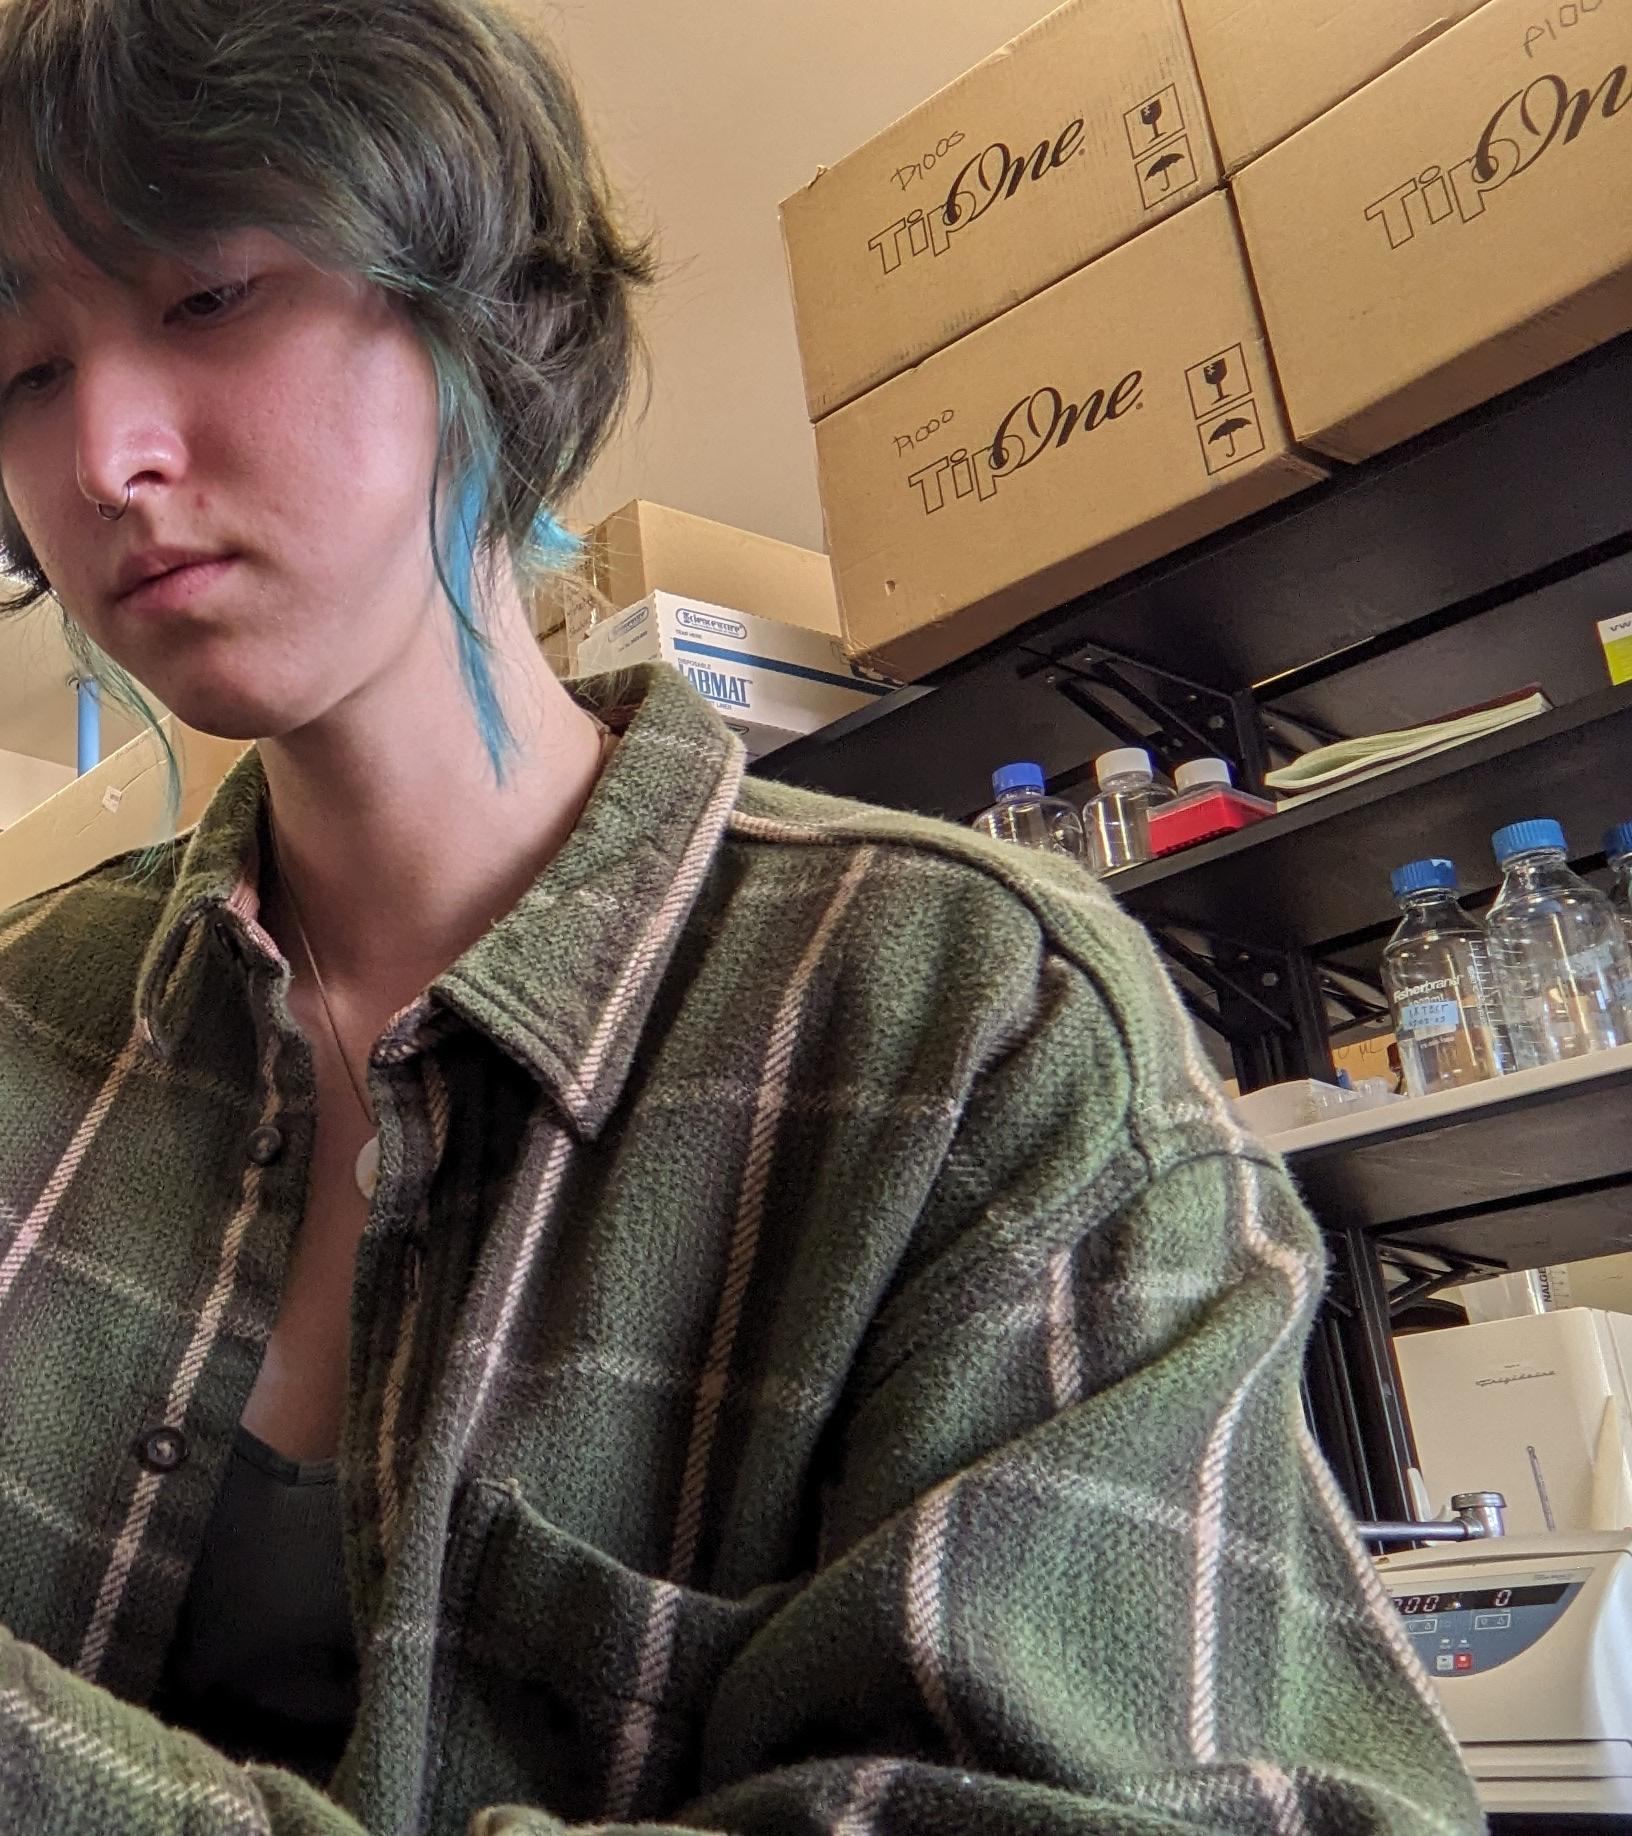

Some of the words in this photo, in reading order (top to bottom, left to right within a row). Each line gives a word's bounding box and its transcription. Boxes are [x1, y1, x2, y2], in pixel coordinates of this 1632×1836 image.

[868, 118, 1086, 275] TipOne
[1364, 64, 1632, 250] TipOn
[908, 370, 1144, 515] TipOne
[1495, 1589, 1512, 1607] 0
